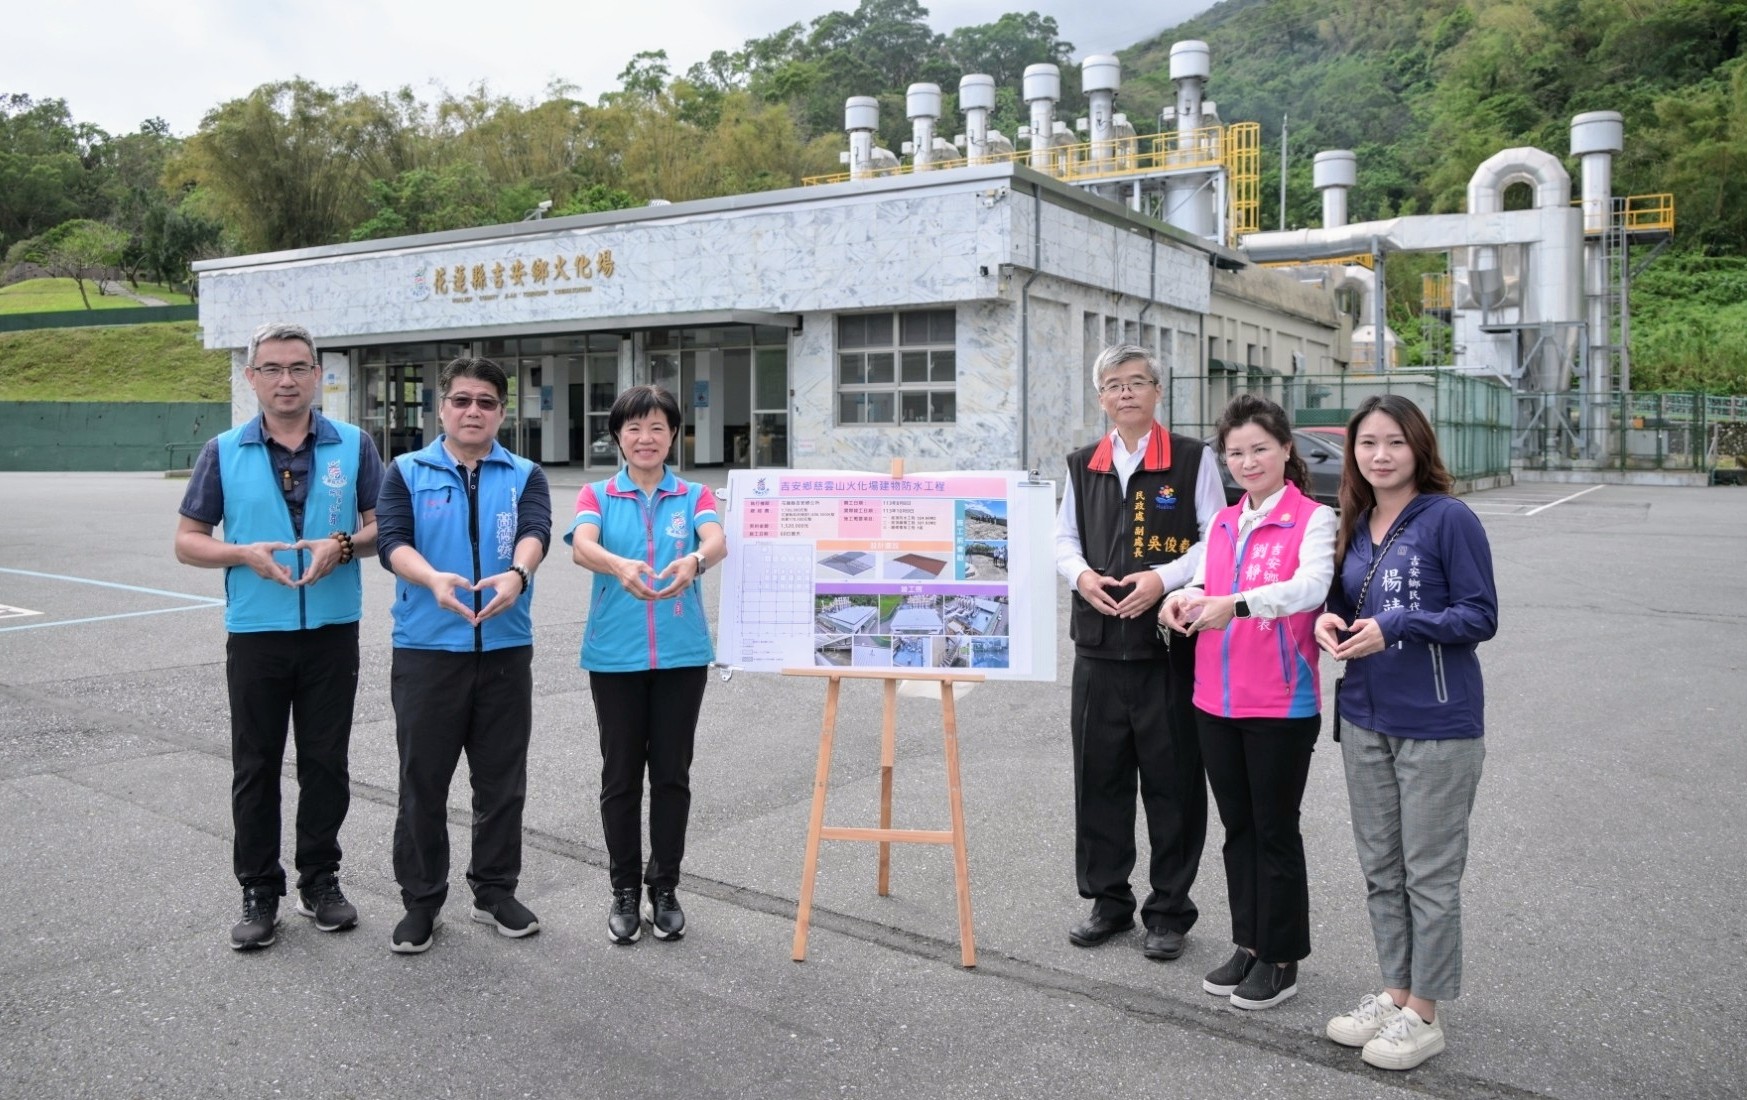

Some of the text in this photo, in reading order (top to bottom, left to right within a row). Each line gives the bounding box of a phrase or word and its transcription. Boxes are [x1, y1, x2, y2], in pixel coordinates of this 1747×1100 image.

[433, 249, 615, 295] 花蓮縣吉安鄉火化場
[1133, 491, 1146, 558] 民政處 副處長
